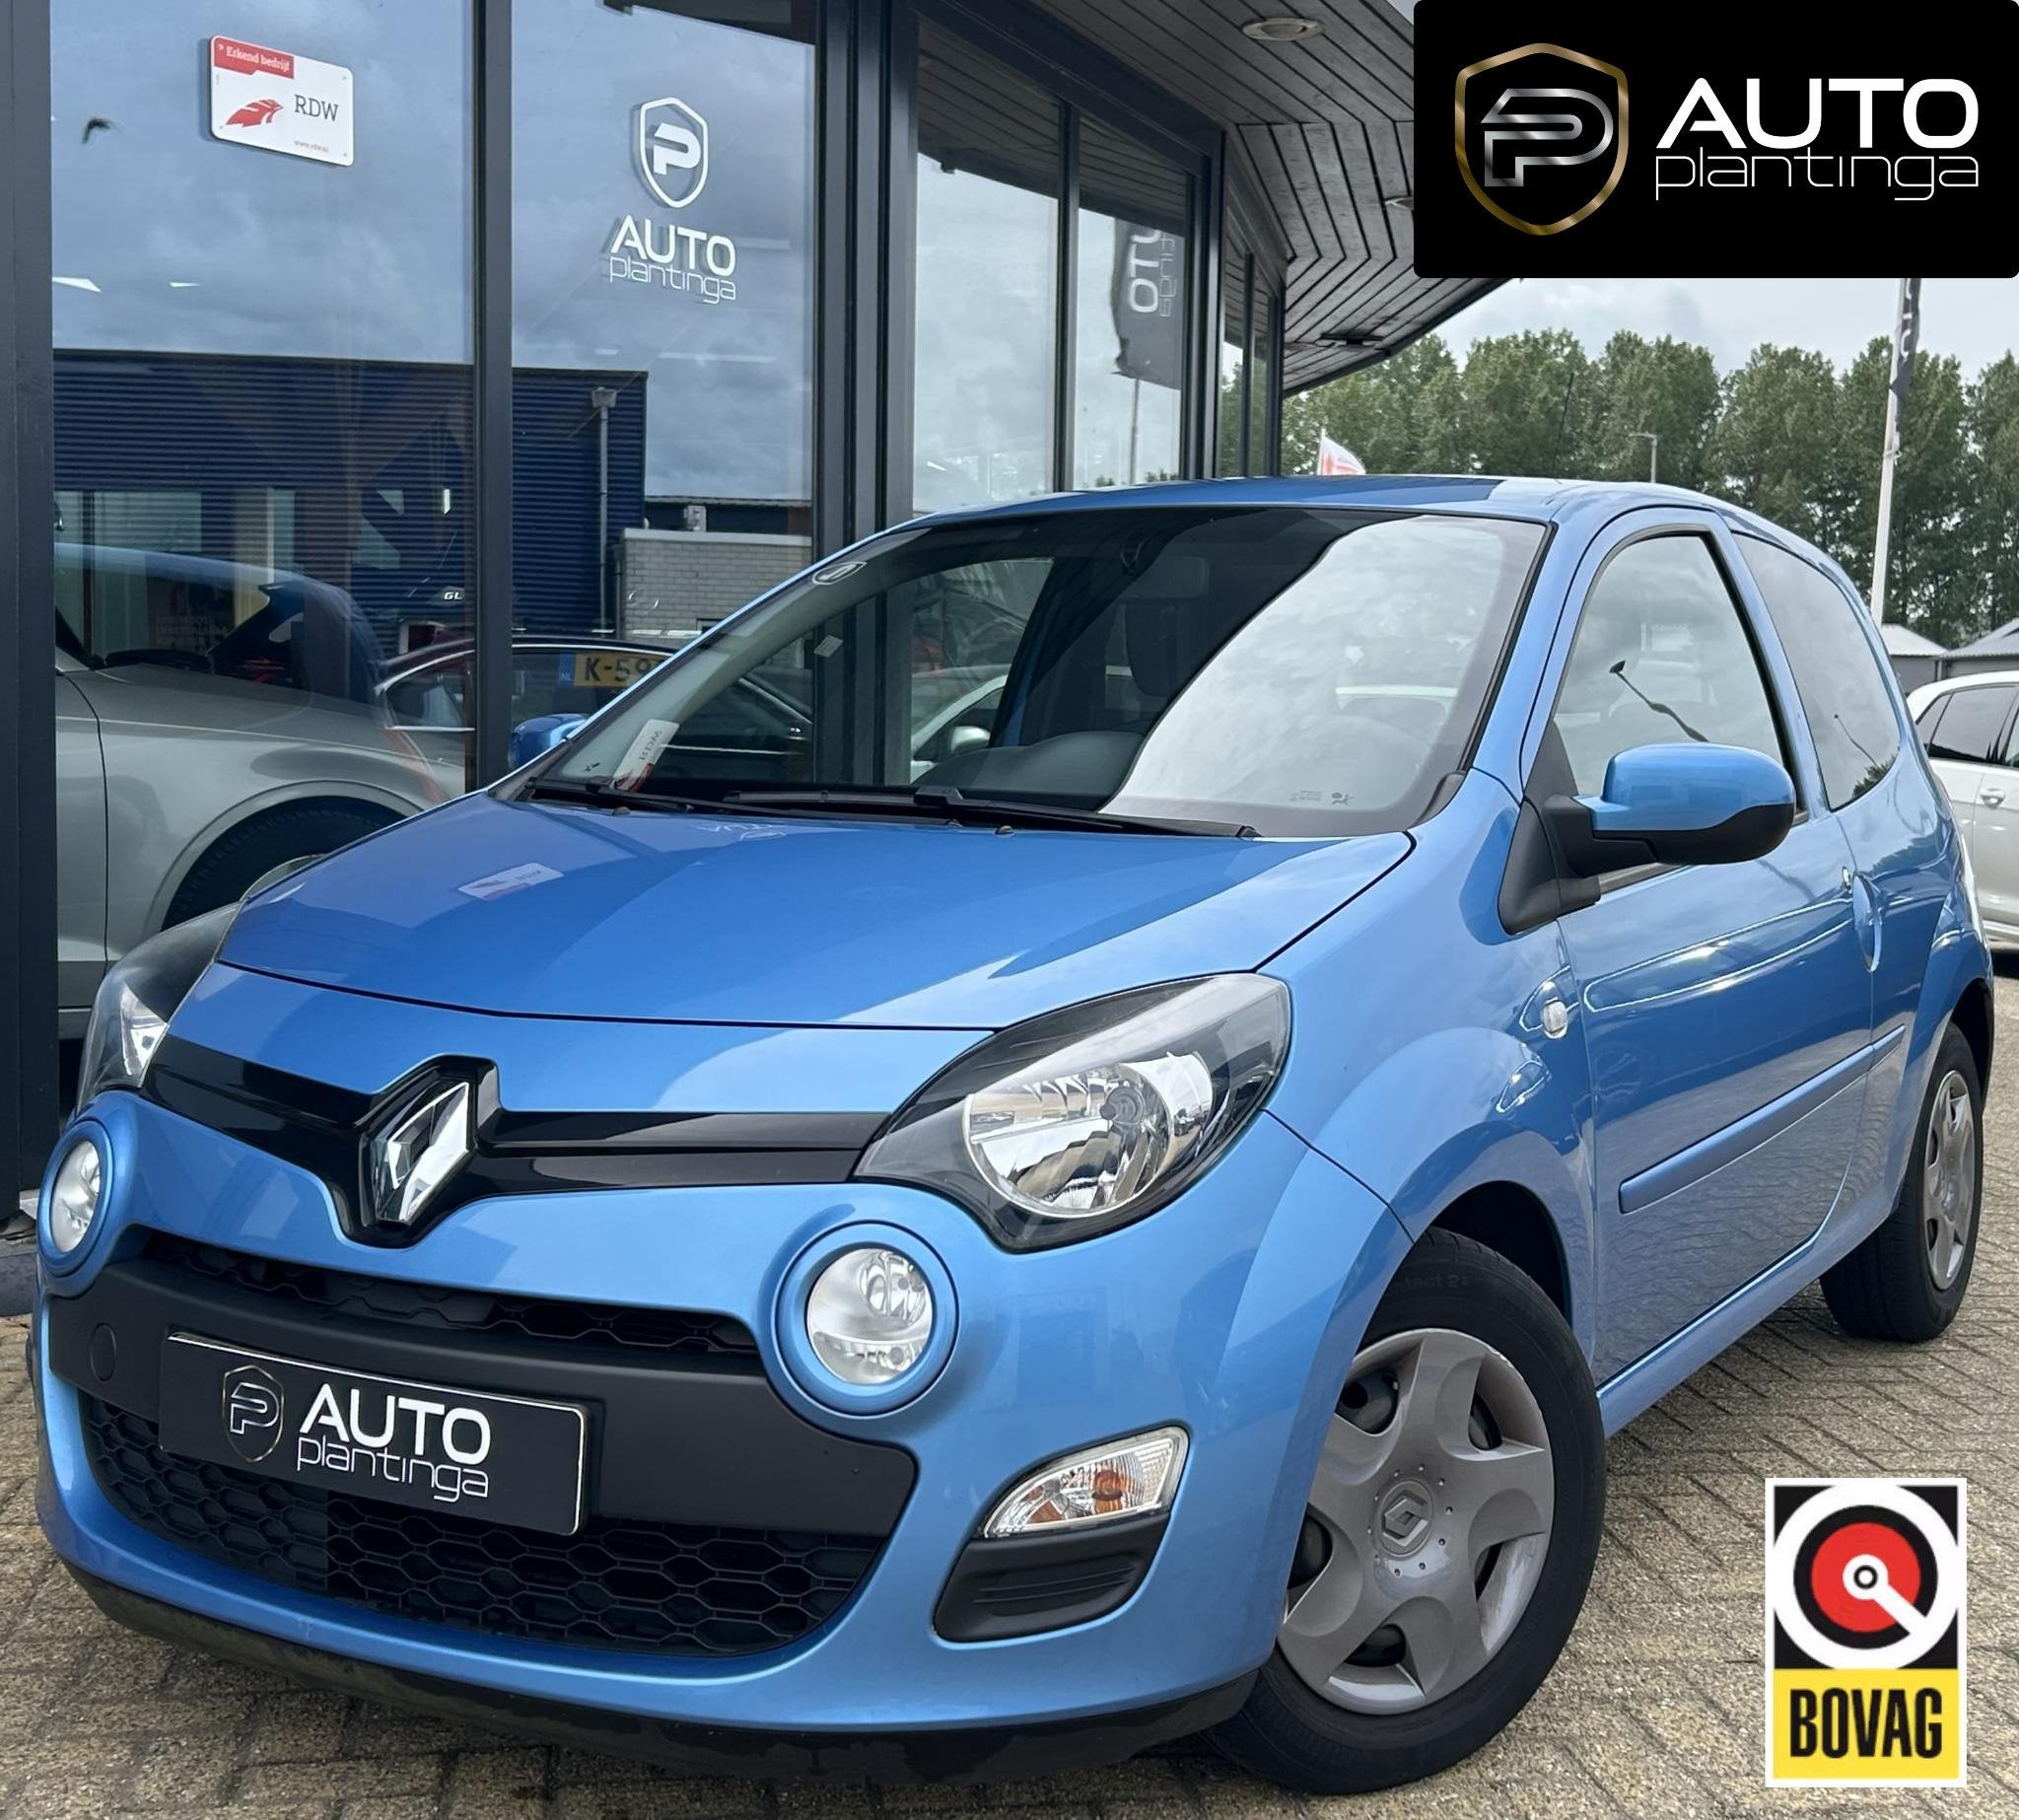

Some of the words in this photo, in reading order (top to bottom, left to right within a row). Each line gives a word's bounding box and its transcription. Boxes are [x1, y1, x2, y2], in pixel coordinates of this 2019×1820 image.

[226, 45, 259, 63] Erkend
[260, 54, 290, 73] bedrijf
[294, 94, 339, 122] RDW
[610, 215, 735, 277] AUTO
[609, 256, 736, 305] plantinga
[299, 1383, 491, 1465] AUTO
[297, 1435, 489, 1504] plantinga
